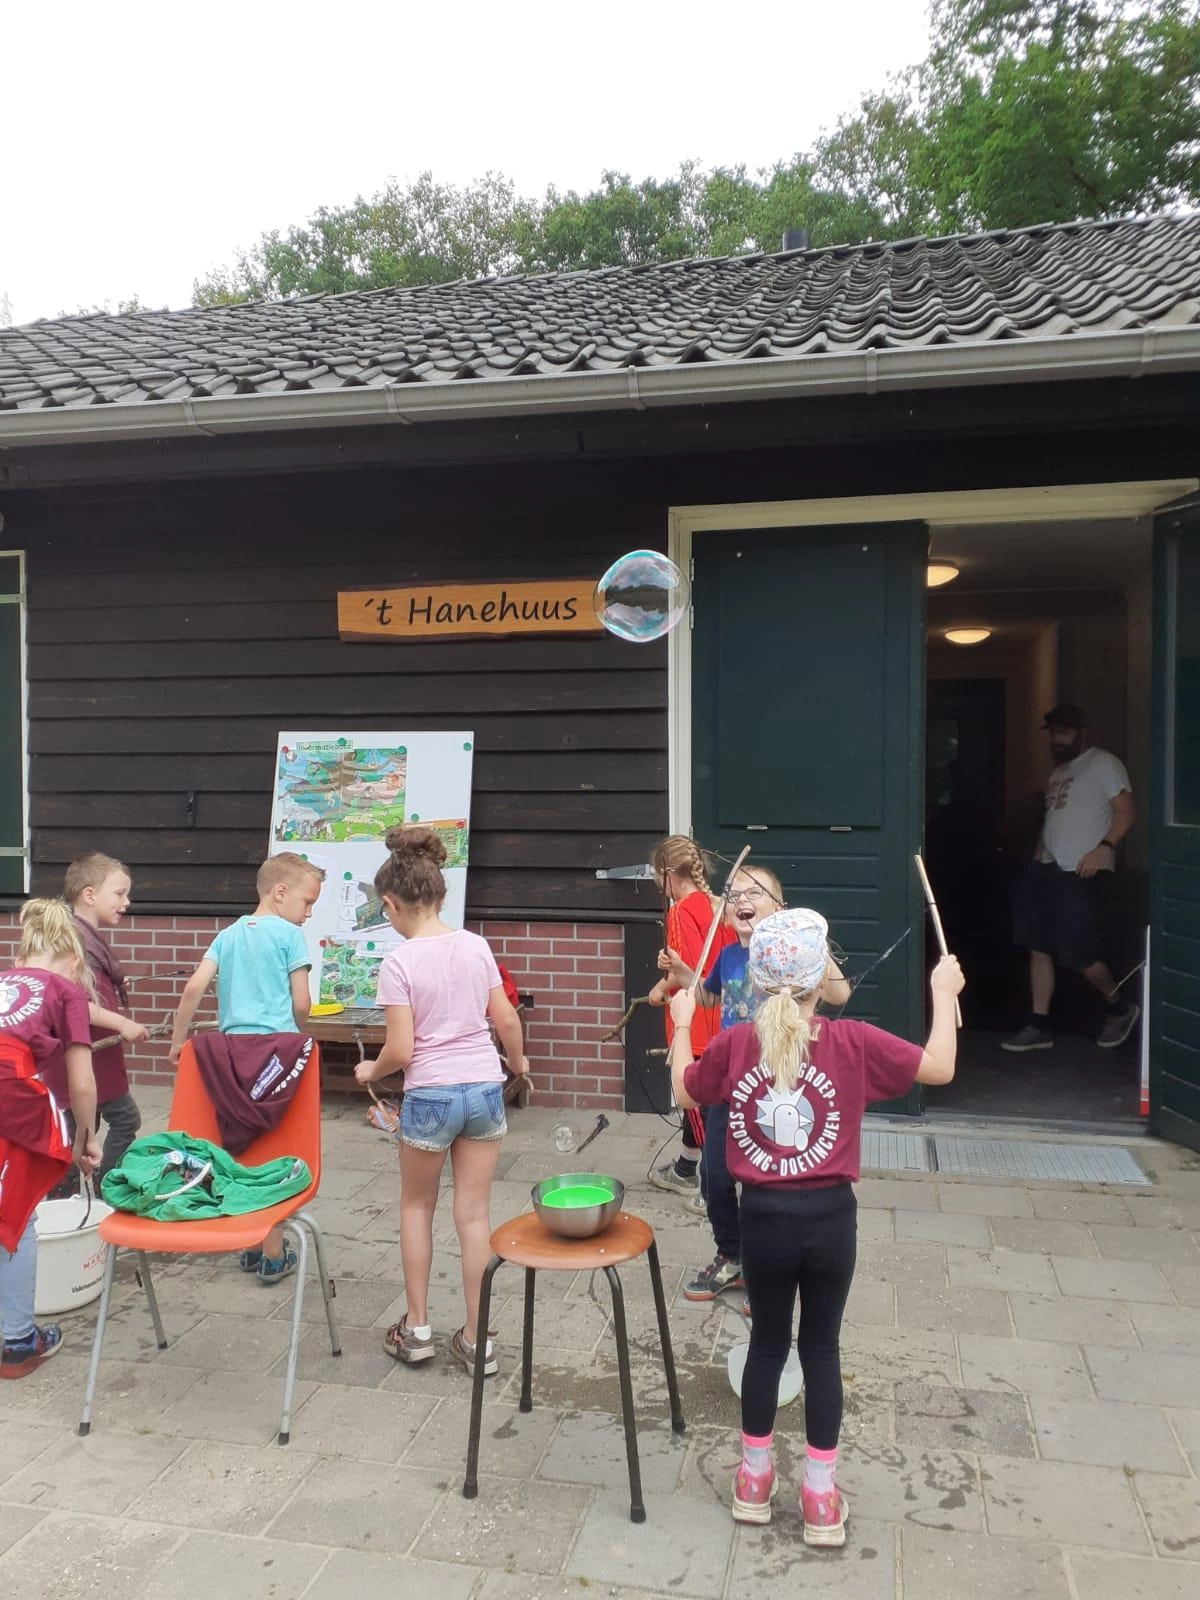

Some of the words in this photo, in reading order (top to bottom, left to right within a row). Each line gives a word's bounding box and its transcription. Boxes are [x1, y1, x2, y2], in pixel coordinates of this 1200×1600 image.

[408, 590, 579, 625] Hanehuus
[729, 1111, 772, 1172] SCOUTING
[780, 1110, 841, 1177] DOETINCHEM
